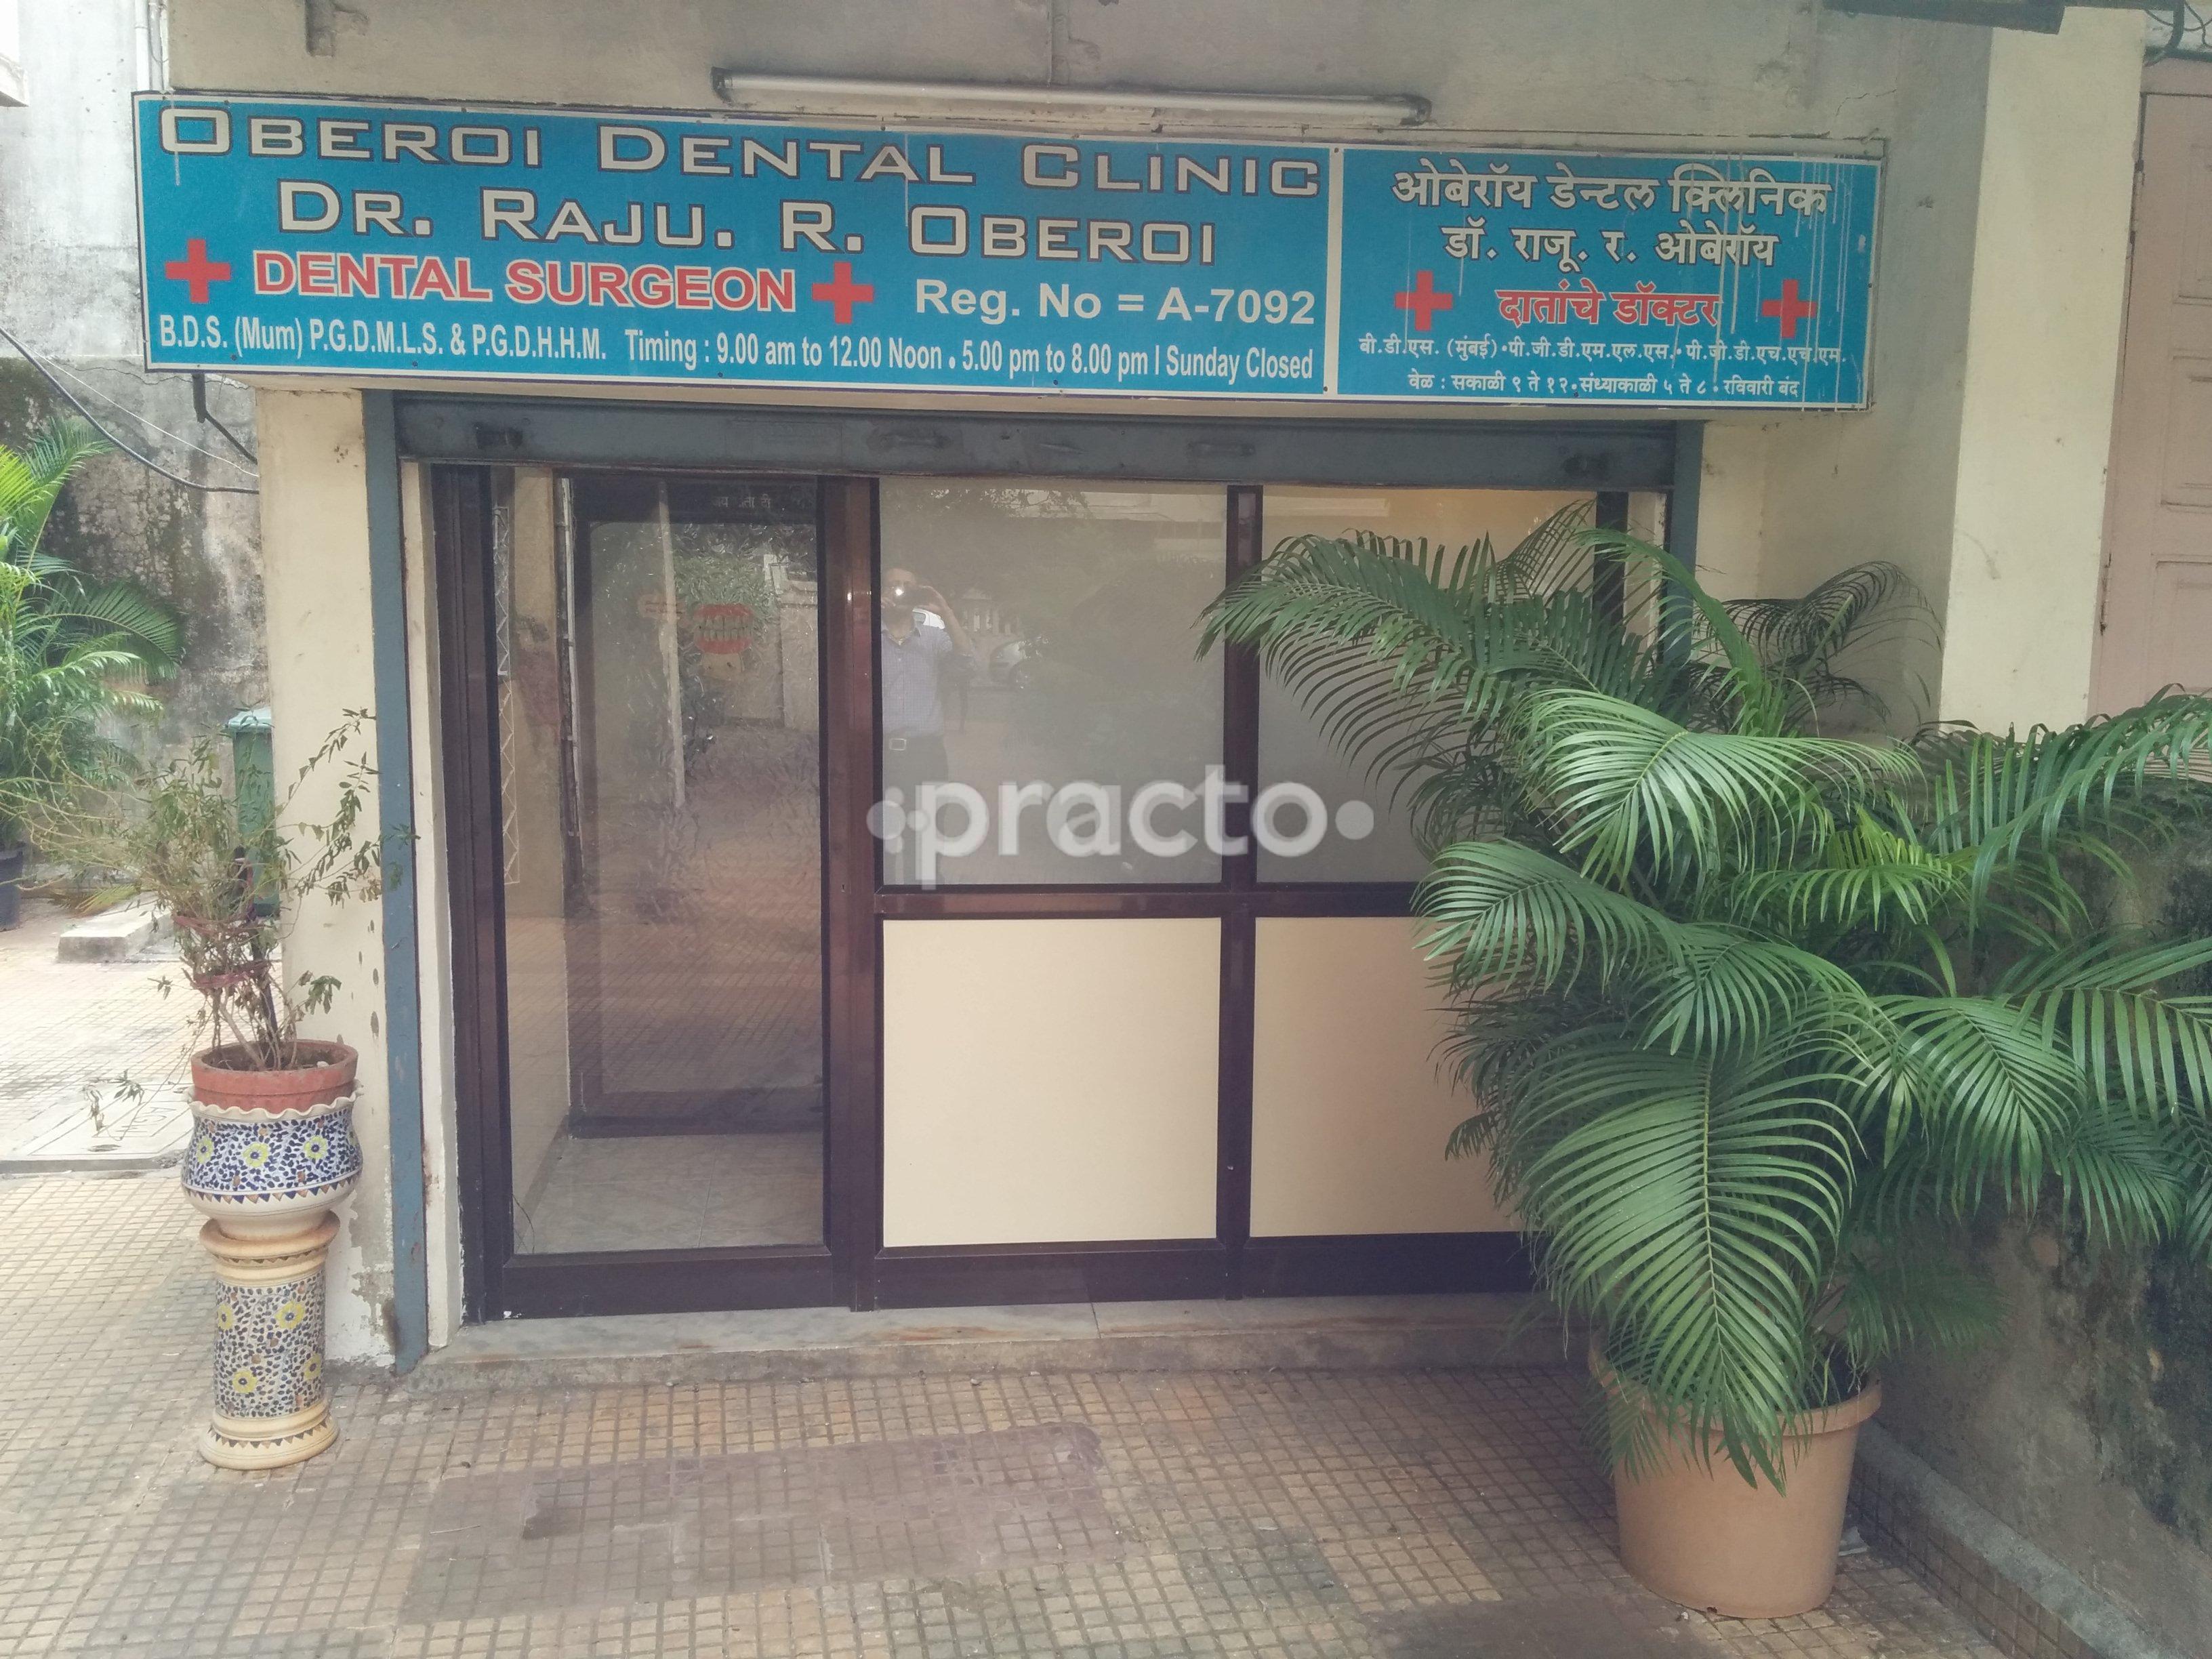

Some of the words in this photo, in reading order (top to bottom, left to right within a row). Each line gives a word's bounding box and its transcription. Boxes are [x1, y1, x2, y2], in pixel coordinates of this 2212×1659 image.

[159, 106, 542, 167] OBEROI
[599, 125, 976, 184] DENTAL
[1021, 142, 1322, 197] CLINIC
[1392, 157, 1538, 208] ओबेरॉय
[1546, 161, 1660, 210] डेन्टल
[1667, 163, 1832, 216] क्लिनिक
[279, 180, 432, 237] DR.
[482, 188, 733, 248] RAJU.
[781, 201, 863, 252] R.
[910, 205, 1213, 264] OBEROI
[1440, 216, 1497, 259] डॉ.
[1510, 228, 1589, 272] राजू.
[1601, 231, 1637, 262] र.
[1655, 219, 1780, 266] ओबेरॉय
[253, 250, 493, 302] DENTAL
[505, 260, 796, 312] SURGEON
[917, 279, 1019, 324] Reg.
[1040, 283, 1101, 318] No
[1158, 287, 1314, 323] A-7092
[1494, 277, 1606, 328] दातांचे
[1609, 281, 1723, 326] डॉक्टर
[161, 315, 227, 348] B.D.S.
[235, 317, 302, 358] (Mum)
[310, 319, 443, 354] P.G.D.M.L.S.
[451, 323, 466, 354] &
[473, 325, 605, 359] P.G.D.H.H.M.
[626, 329, 696, 370] Timing
[717, 333, 758, 364] 9.00
[766, 342, 795, 365] am
[802, 337, 821, 365] to
[830, 336, 881, 367] 12.00
[889, 337, 941, 369] Noon
[963, 340, 1002, 371] 5.00
[1010, 349, 1039, 379] pm
[1046, 344, 1065, 373] to
[1072, 343, 1111, 373] 8.00
[1119, 352, 1147, 382] pm
[1166, 346, 1240, 384] Sunday
[1247, 348, 1312, 378] Closed
[1359, 332, 1439, 359] बी.डी.एस.
[1408, 368, 1436, 390] वेळ
[1451, 370, 1506, 392] सकाळी
[1528, 370, 1540, 392] ते
[1679, 373, 1692, 395] ते
[1723, 375, 1774, 396] रविवारी
[1778, 376, 1800, 398] बंद
